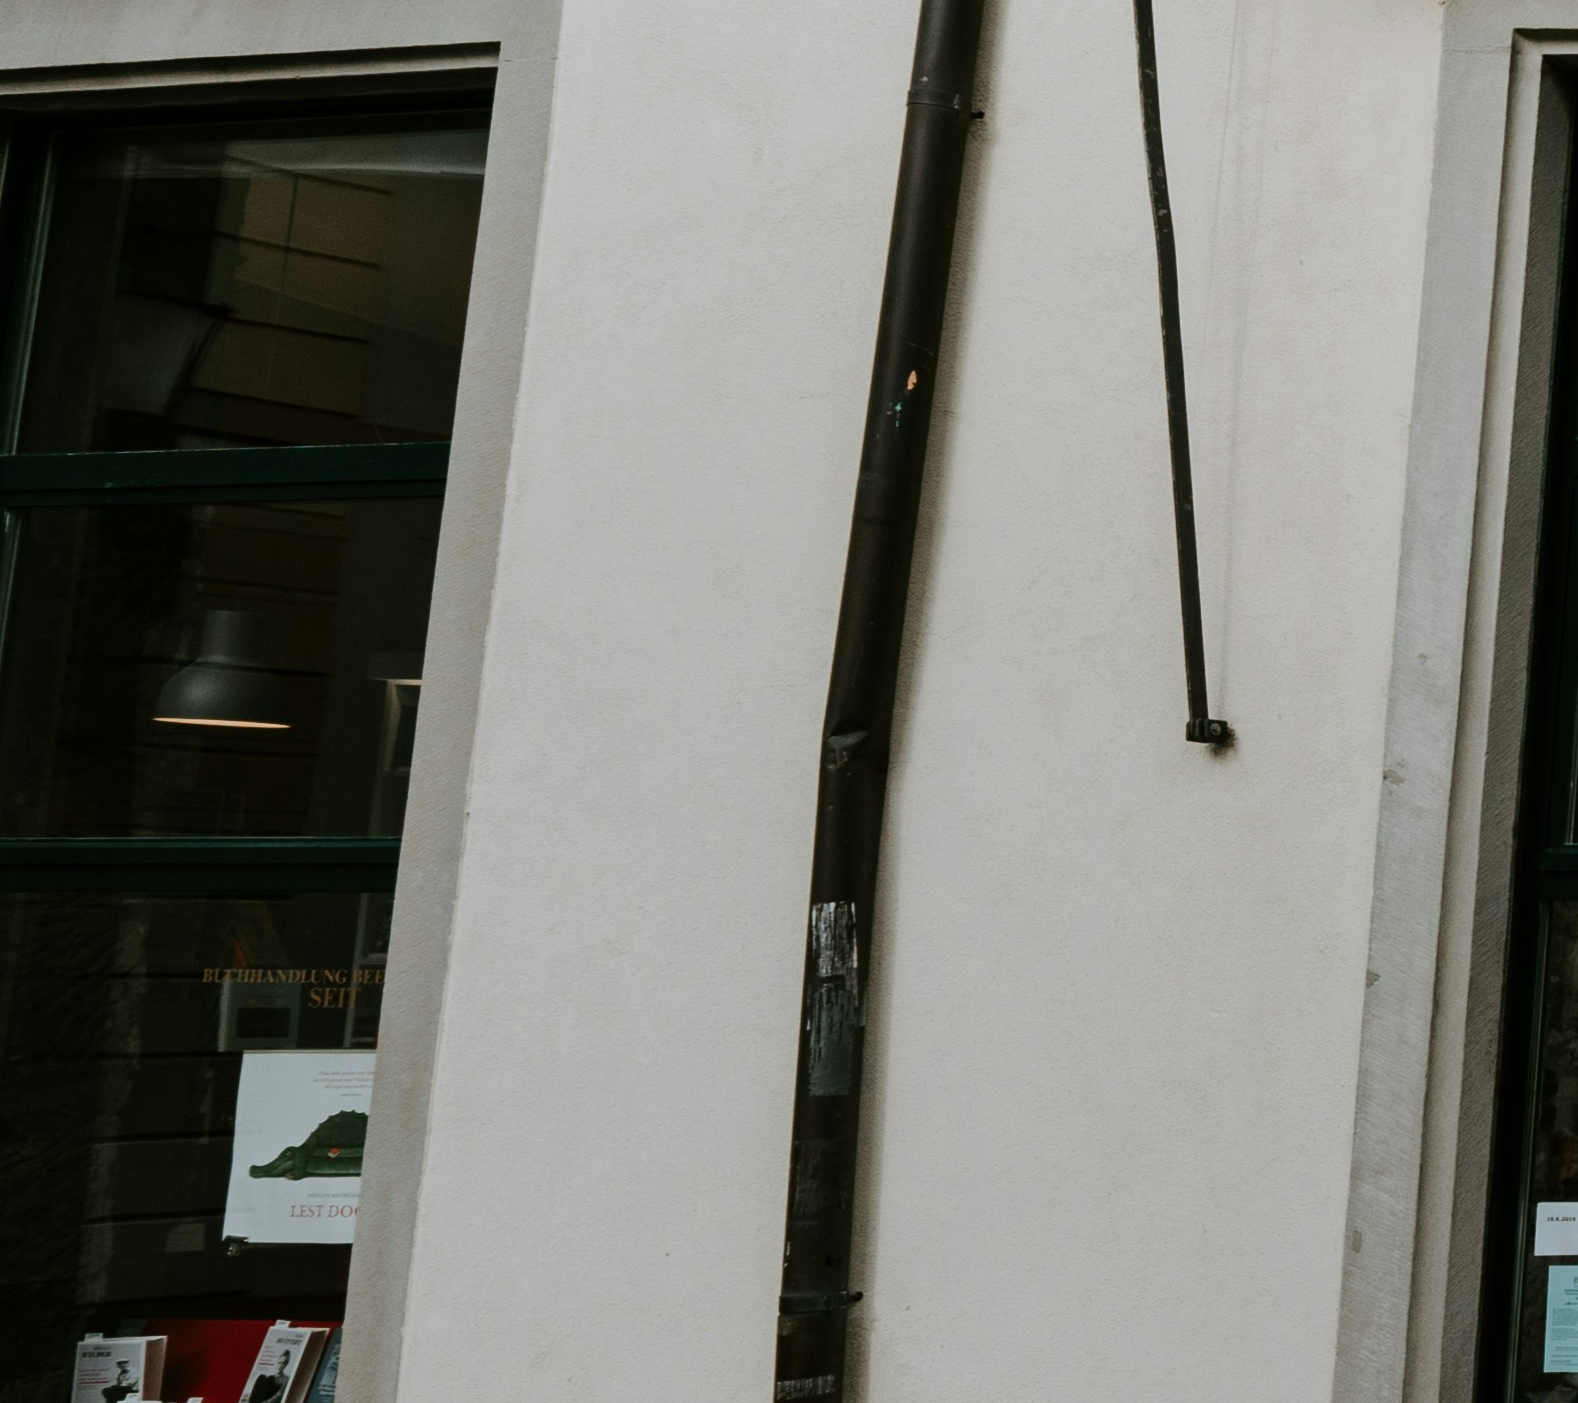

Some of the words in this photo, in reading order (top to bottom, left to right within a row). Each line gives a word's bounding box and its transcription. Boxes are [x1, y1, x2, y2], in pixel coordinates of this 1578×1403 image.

[202, 968, 348, 984] BUCHHANDLUNG
[352, 969, 385, 984] BEE
[308, 987, 362, 1008] SEIT
[290, 1204, 324, 1218] LEST
